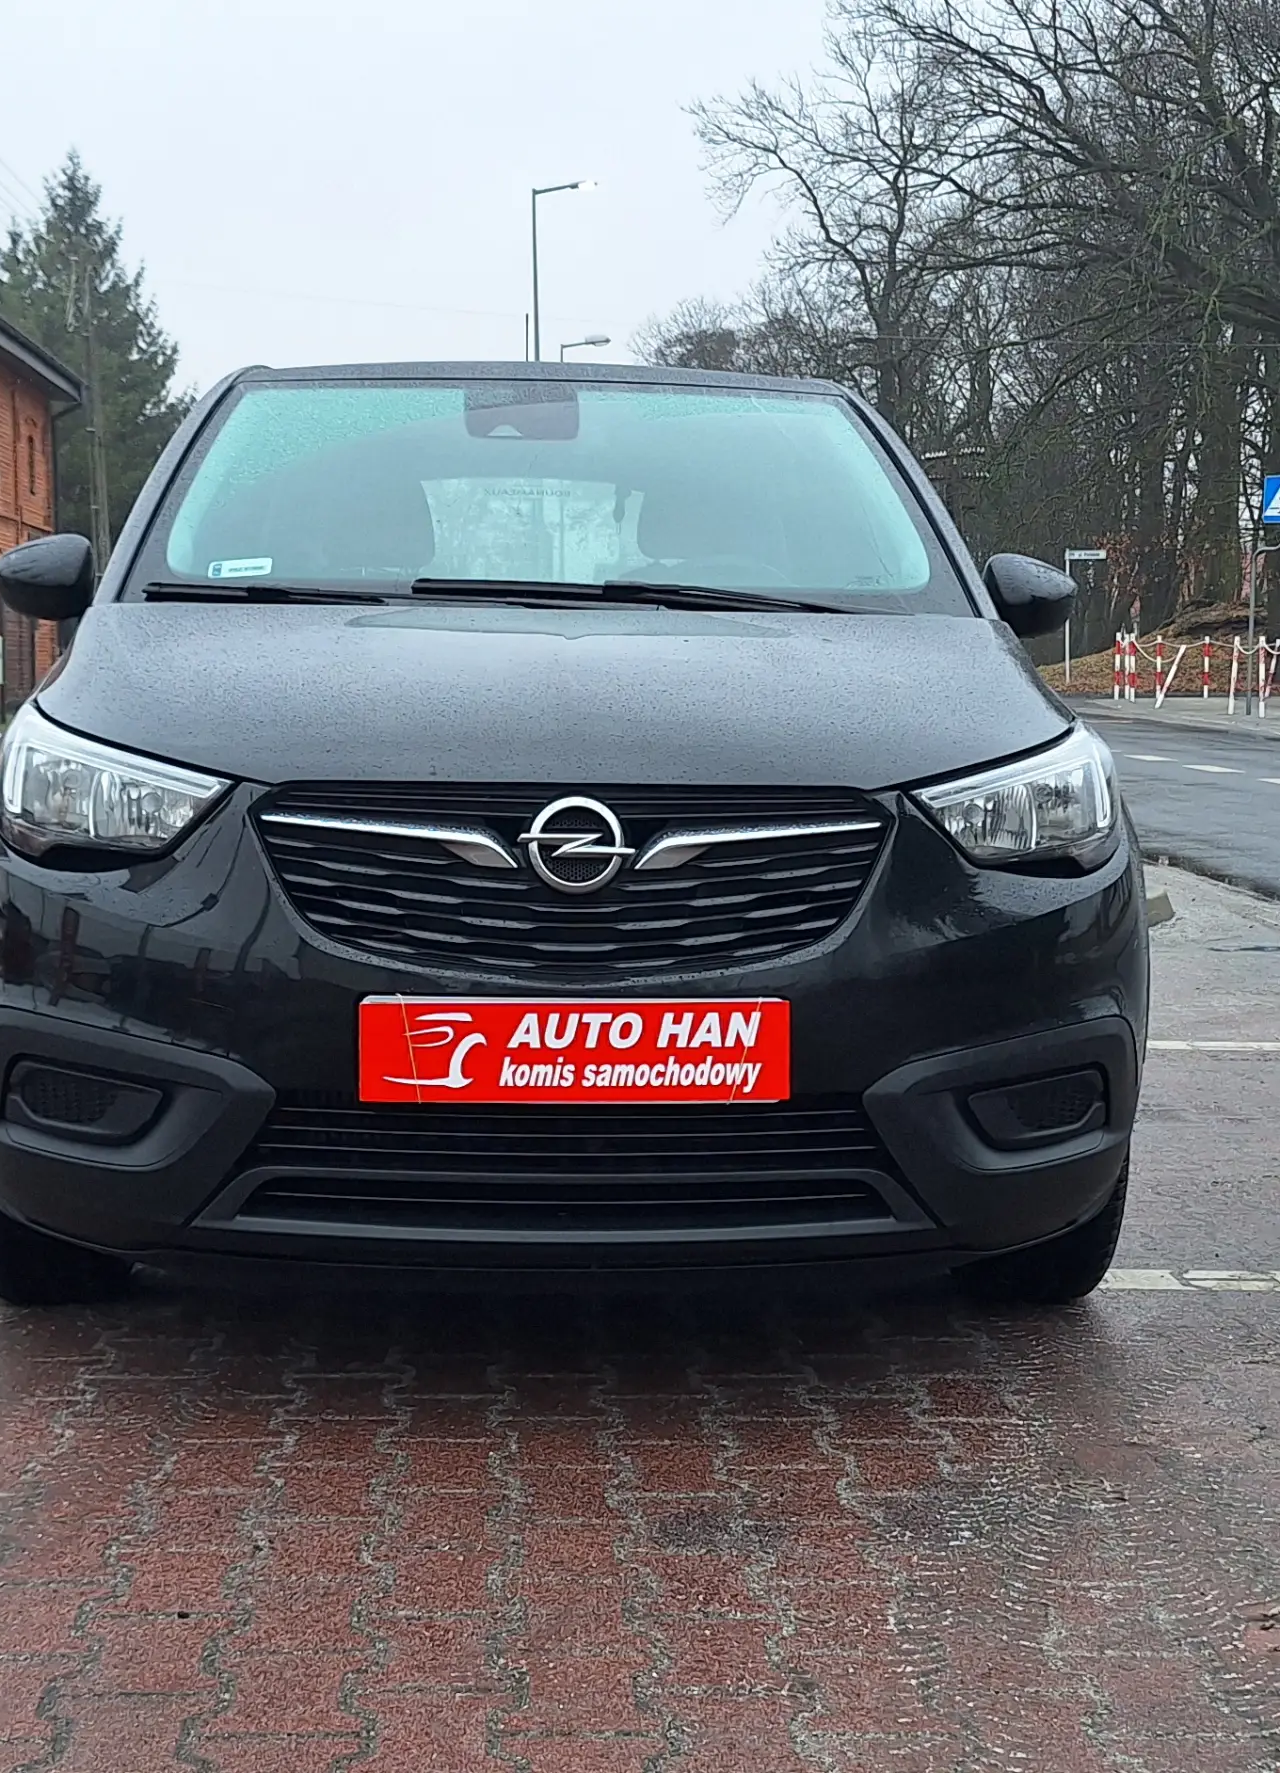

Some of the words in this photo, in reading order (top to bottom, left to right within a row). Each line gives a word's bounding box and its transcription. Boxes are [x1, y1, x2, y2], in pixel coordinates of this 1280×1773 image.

[506, 1011, 643, 1049] AUTO
[655, 1010, 762, 1049] HAN
[498, 1056, 575, 1087] komis
[581, 1056, 762, 1093] samochodowy
